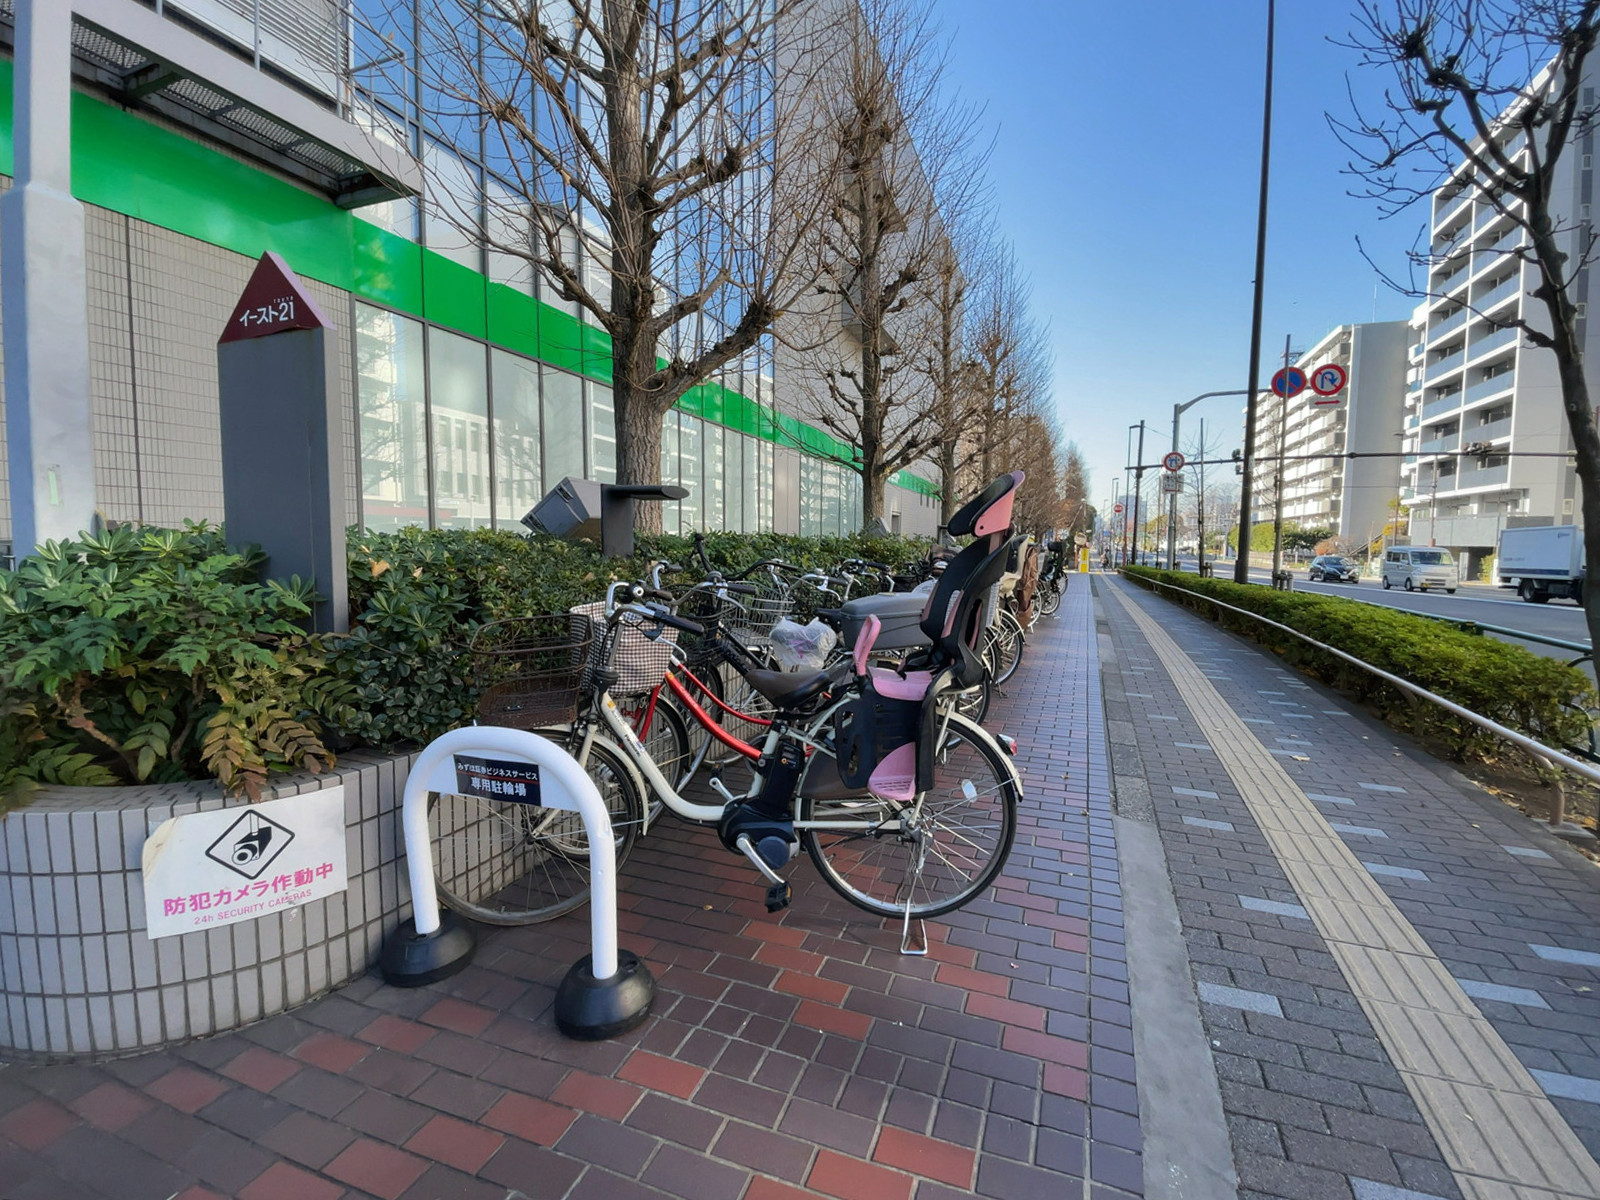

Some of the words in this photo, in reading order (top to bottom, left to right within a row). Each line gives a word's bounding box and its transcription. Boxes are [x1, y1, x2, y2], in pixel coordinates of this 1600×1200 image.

[471, 777, 526, 796] 専用駐輪場
[164, 863, 333, 916] 防犯カメラ作動中
[193, 915, 214, 925] 24h
[217, 902, 265, 920] SECURITY
[268, 889, 312, 908] CAMERAS
